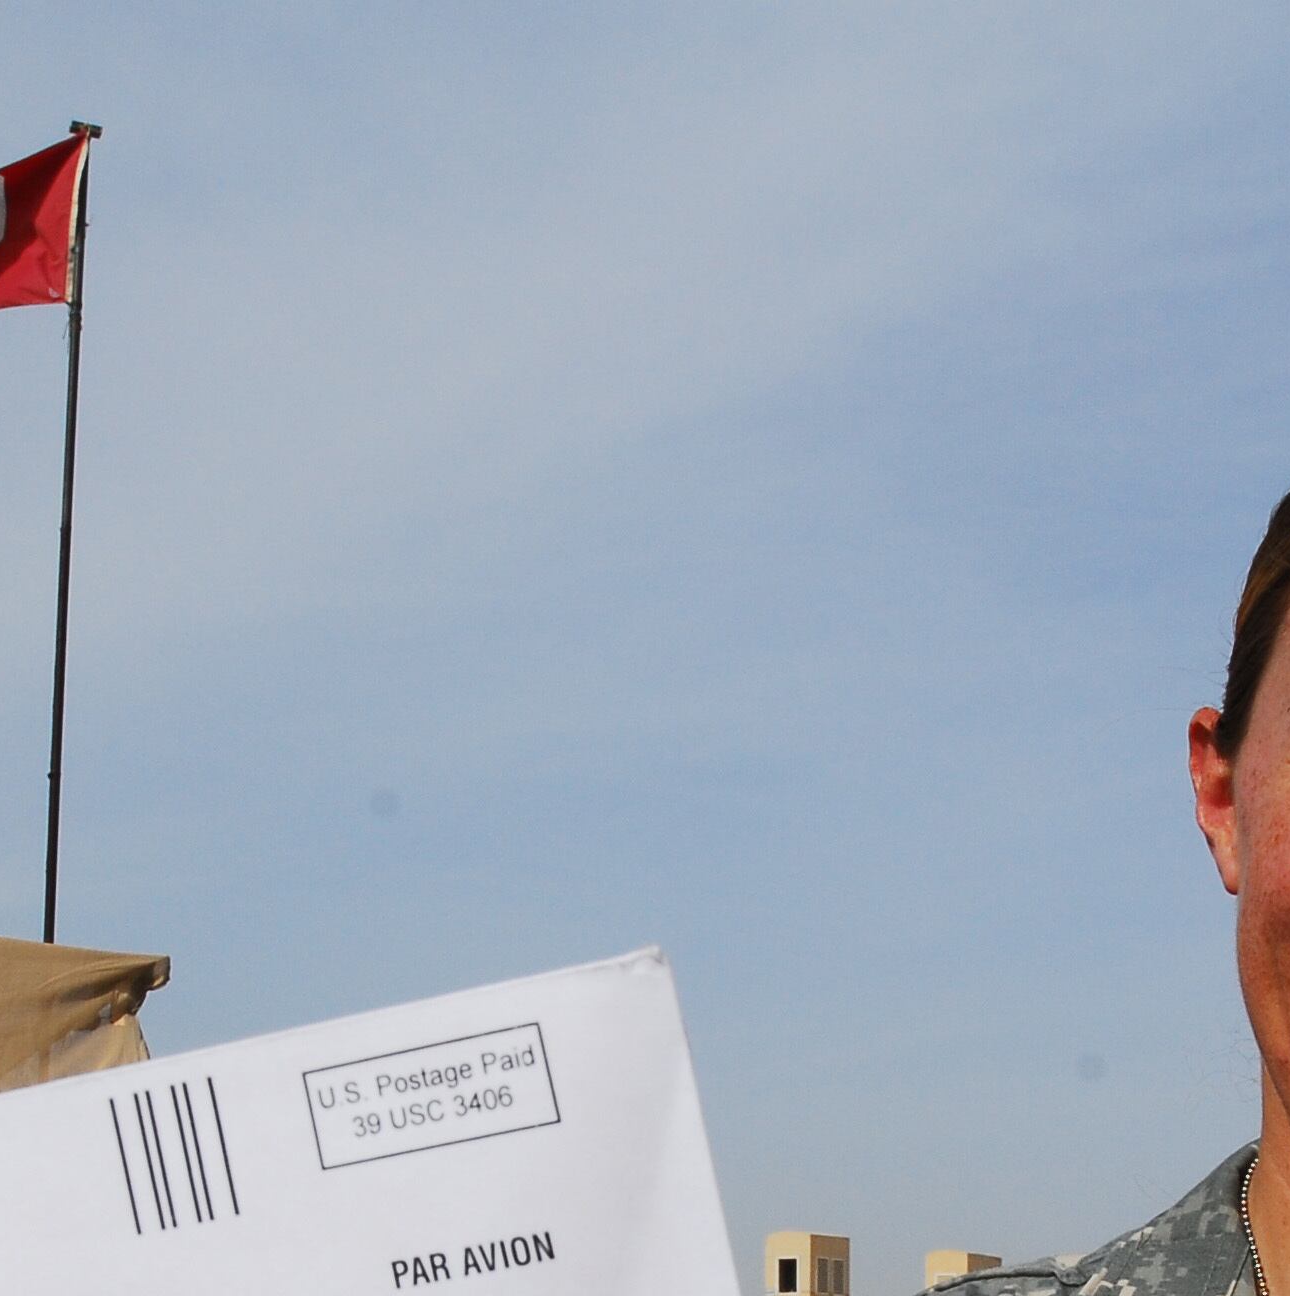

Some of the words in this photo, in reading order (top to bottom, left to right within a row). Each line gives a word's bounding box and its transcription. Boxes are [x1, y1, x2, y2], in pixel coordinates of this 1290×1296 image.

[317, 1081, 369, 1109] U.S.
[376, 1057, 473, 1098] Postage
[481, 1044, 536, 1076] Paid
[353, 1110, 382, 1138] 39
[389, 1100, 445, 1130] USC
[454, 1085, 514, 1117] 3406
[391, 1252, 451, 1289] PAR
[463, 1231, 556, 1276] AVION
